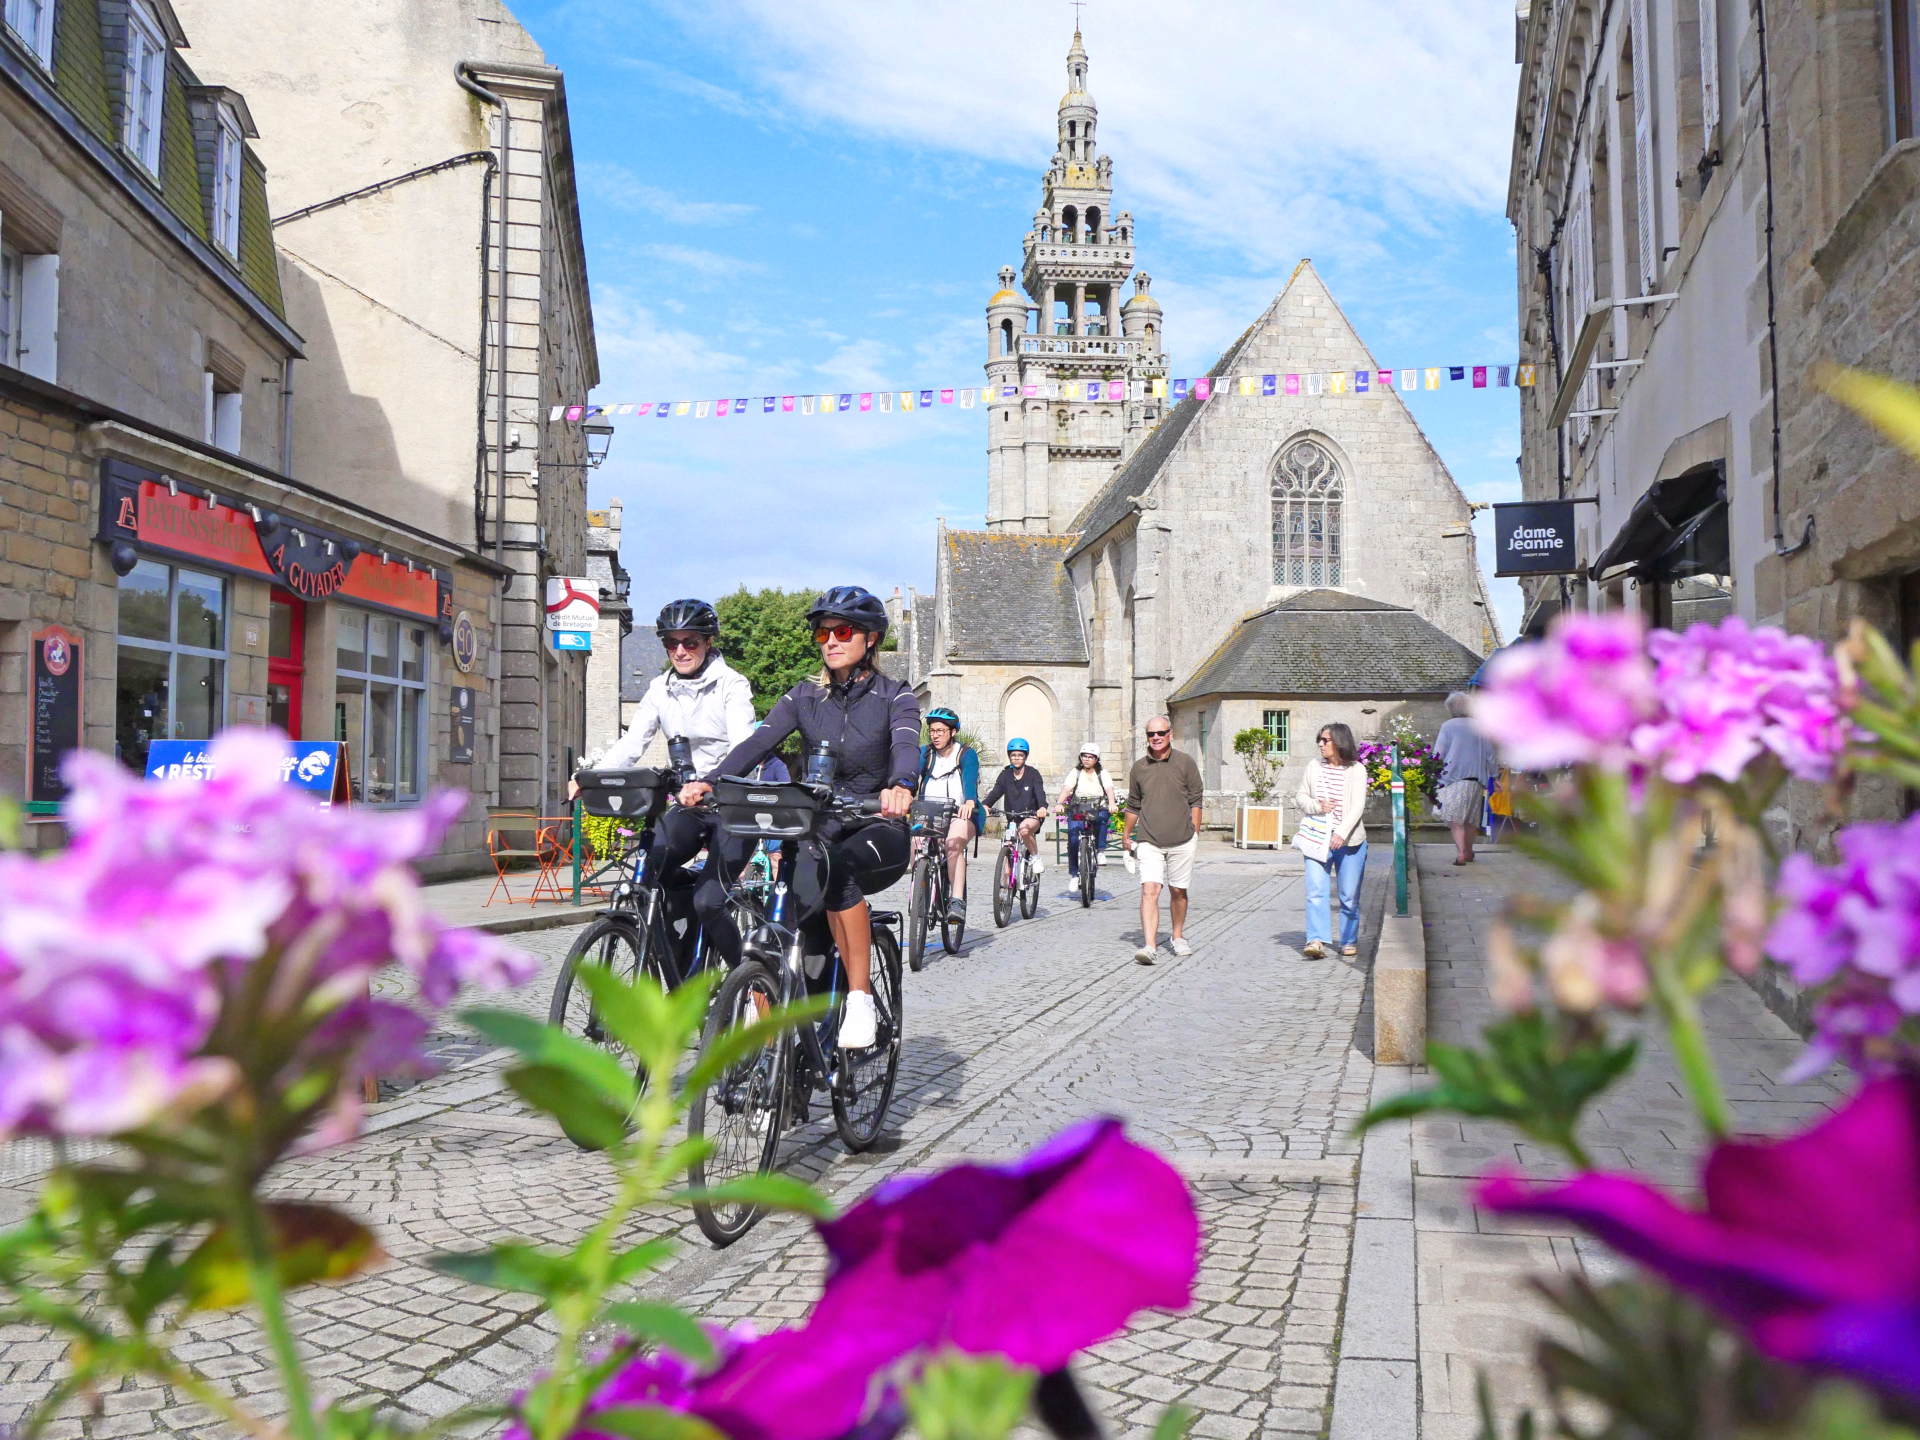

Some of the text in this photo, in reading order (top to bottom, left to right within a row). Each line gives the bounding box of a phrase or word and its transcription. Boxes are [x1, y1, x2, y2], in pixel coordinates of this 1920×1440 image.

[145, 497, 251, 554] PATISSERIE
[1513, 525, 1556, 540] dame
[289, 561, 346, 598] GUYADER
[361, 565, 392, 593] Salon
[394, 574, 407, 597] de
[550, 613, 571, 621] Crédit
[182, 751, 195, 763] le
